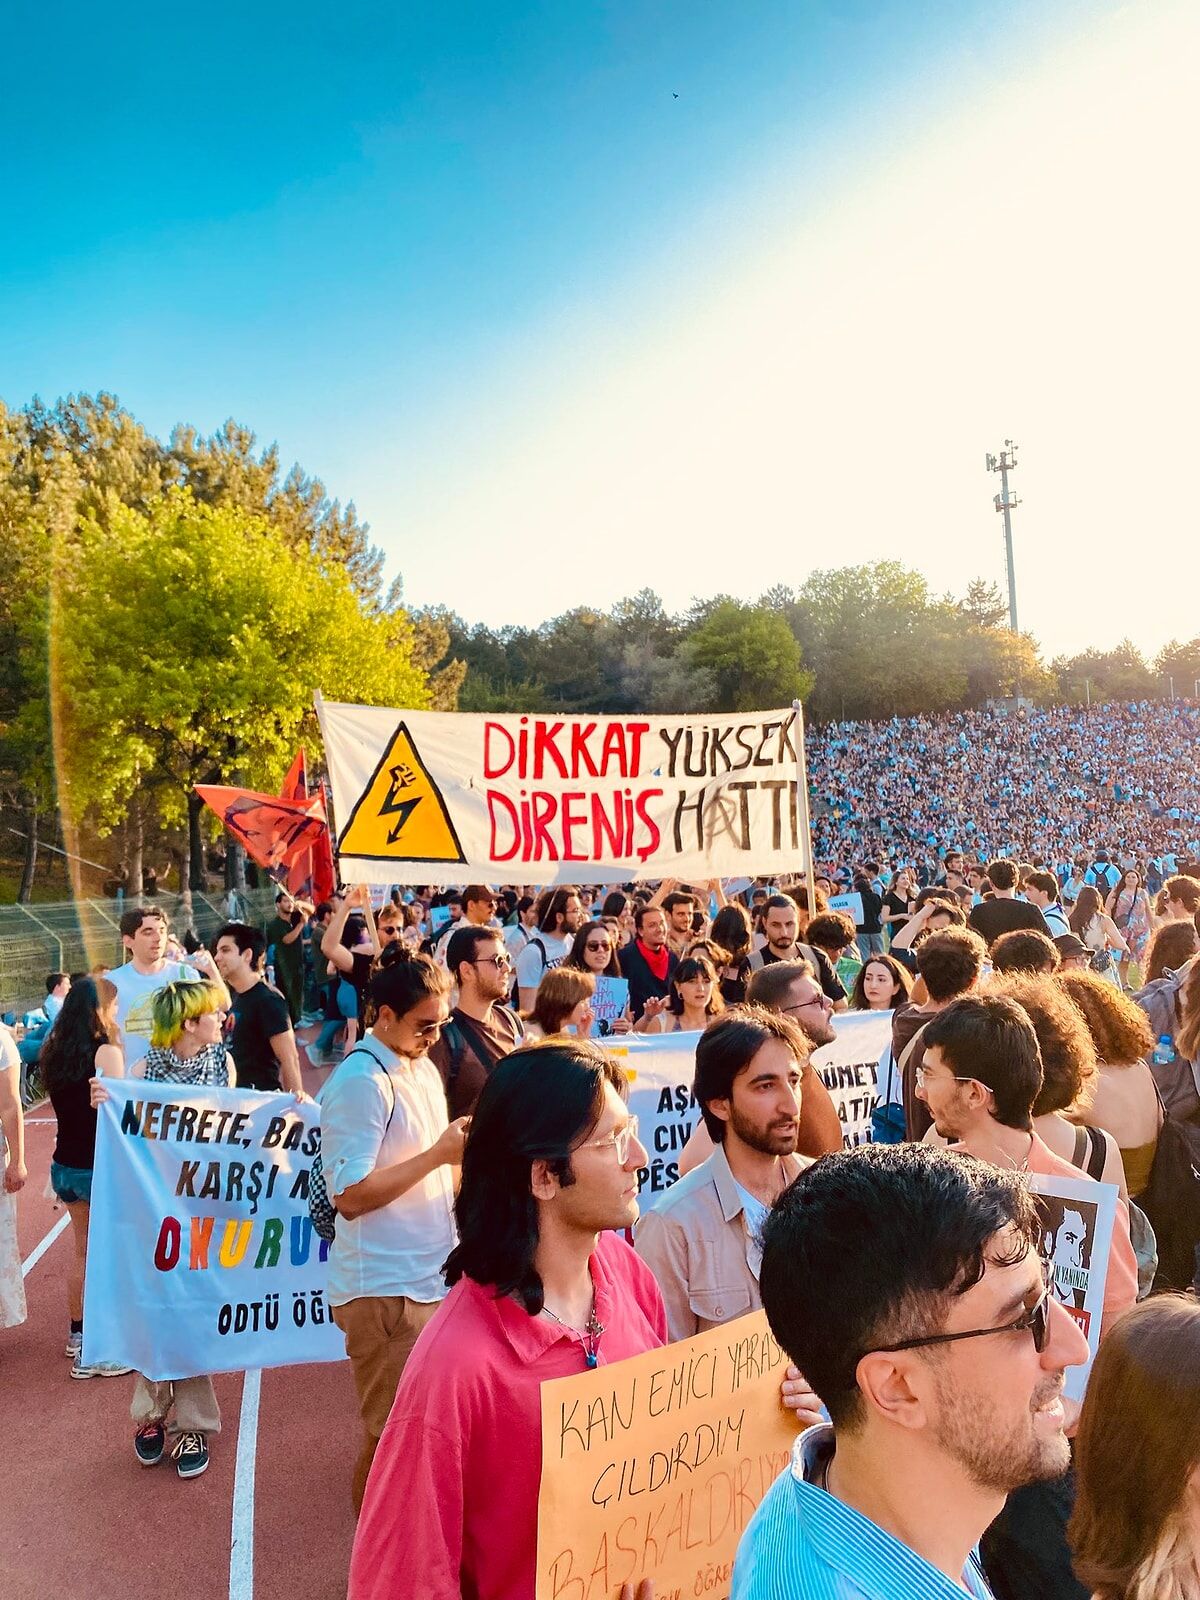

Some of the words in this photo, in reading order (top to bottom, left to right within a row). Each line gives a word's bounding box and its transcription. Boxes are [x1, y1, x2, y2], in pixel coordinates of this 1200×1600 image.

[484, 716, 650, 779] DİKKAT
[660, 712, 798, 778] YÜKSEK
[487, 788, 664, 863] DİRENİŞ
[812, 1061, 880, 1091] ÛMET
[121, 1099, 252, 1149] NEFRETE,
[261, 1116, 322, 1156] BAS
[175, 1160, 280, 1215] KARŞI
[218, 1293, 280, 1335] ODTÜ
[560, 1378, 637, 1459] KAN
[649, 1347, 717, 1417] EMİCİ
[727, 1332, 790, 1393] YARAS
[591, 1408, 745, 1509] ÇILDIRDIM
[694, 1561, 735, 1597] ÖĞRE
